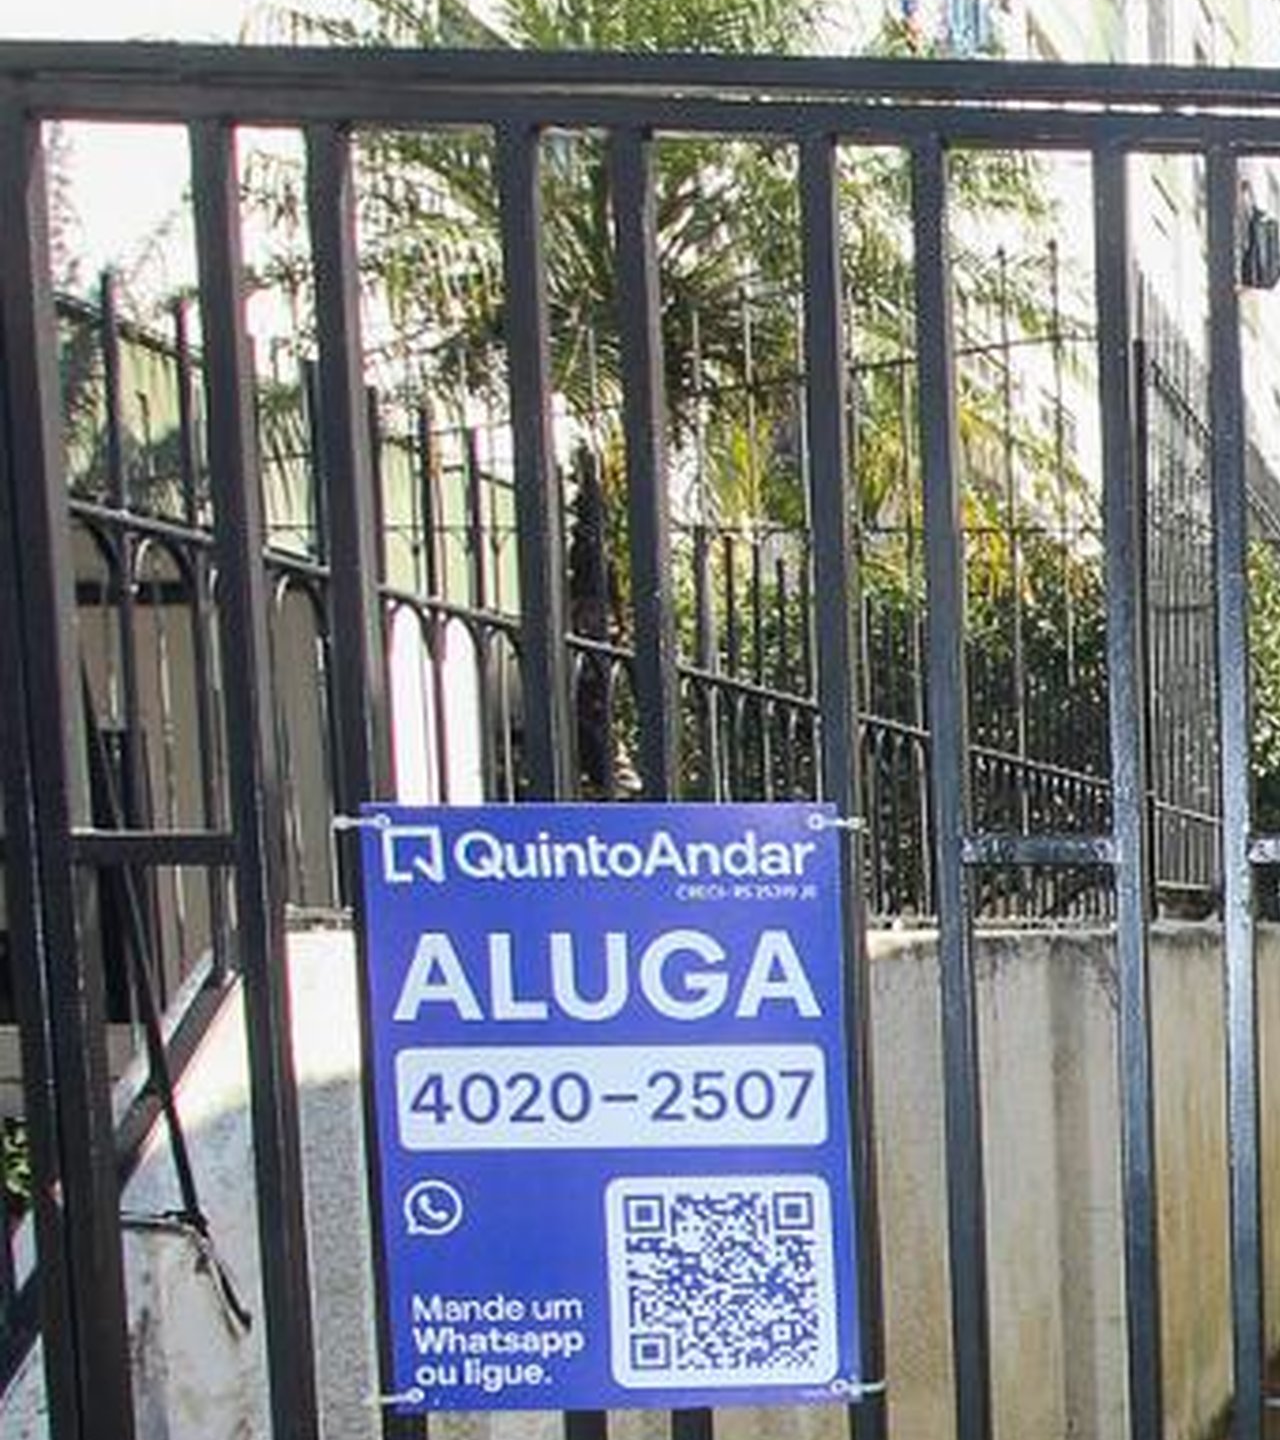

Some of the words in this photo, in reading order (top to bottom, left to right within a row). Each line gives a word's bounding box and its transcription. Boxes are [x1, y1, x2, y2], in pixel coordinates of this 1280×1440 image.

[453, 829, 816, 879] QuintoAndar
[393, 929, 823, 1022] ALUGA
[410, 1070, 816, 1126] 4020-2507
[412, 1294, 526, 1322] Mande
[531, 1298, 583, 1321] um
[412, 1326, 585, 1358] Whatsapp
[415, 1364, 458, 1386] ou
[463, 1358, 553, 1393] ligue.
